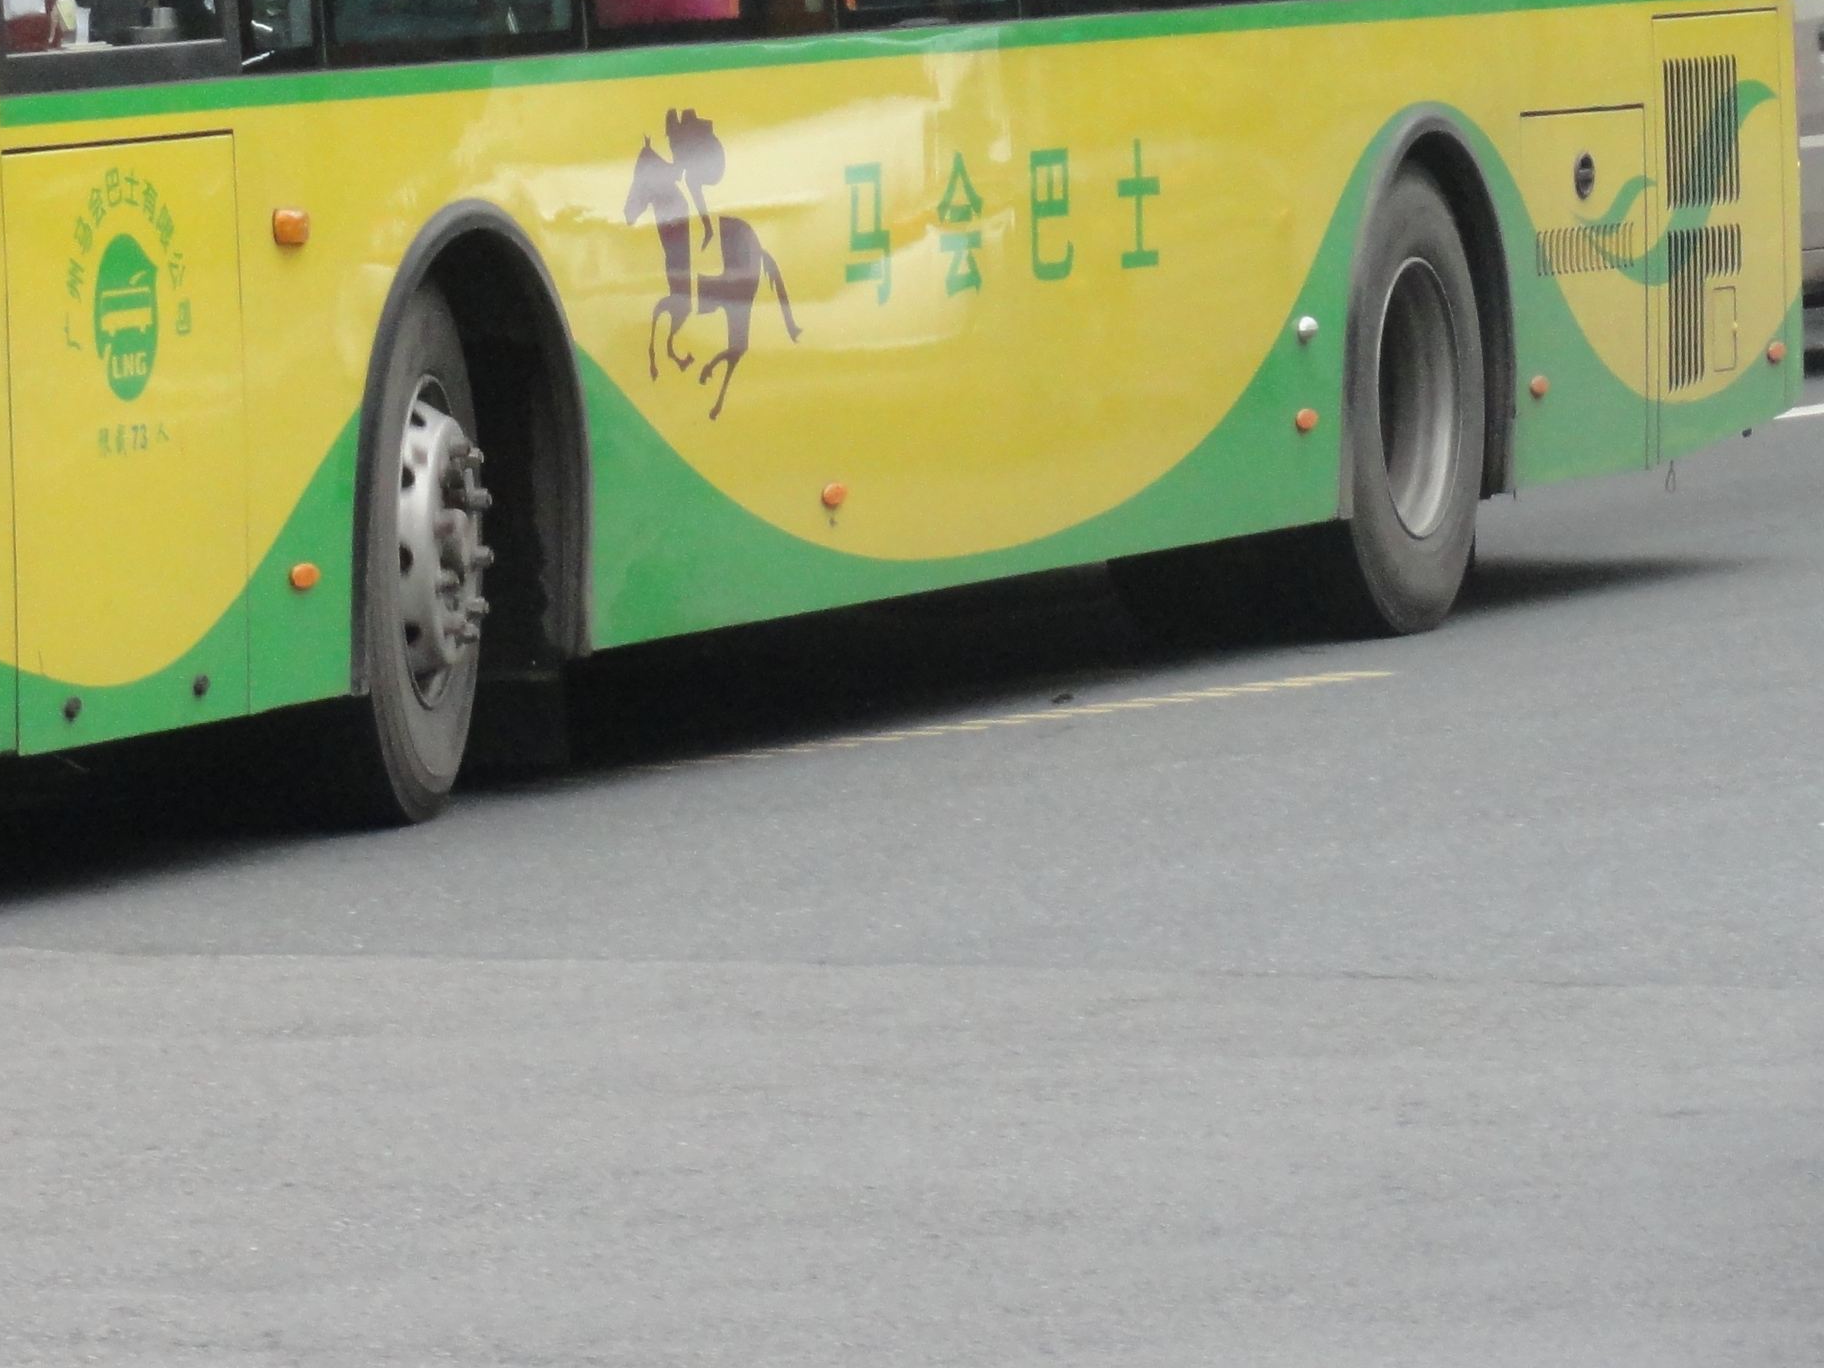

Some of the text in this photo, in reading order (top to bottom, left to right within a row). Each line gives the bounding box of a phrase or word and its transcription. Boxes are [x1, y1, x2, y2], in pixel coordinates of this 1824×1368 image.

[843, 138, 1162, 307] 马会巴士
[112, 352, 147, 379] LNG
